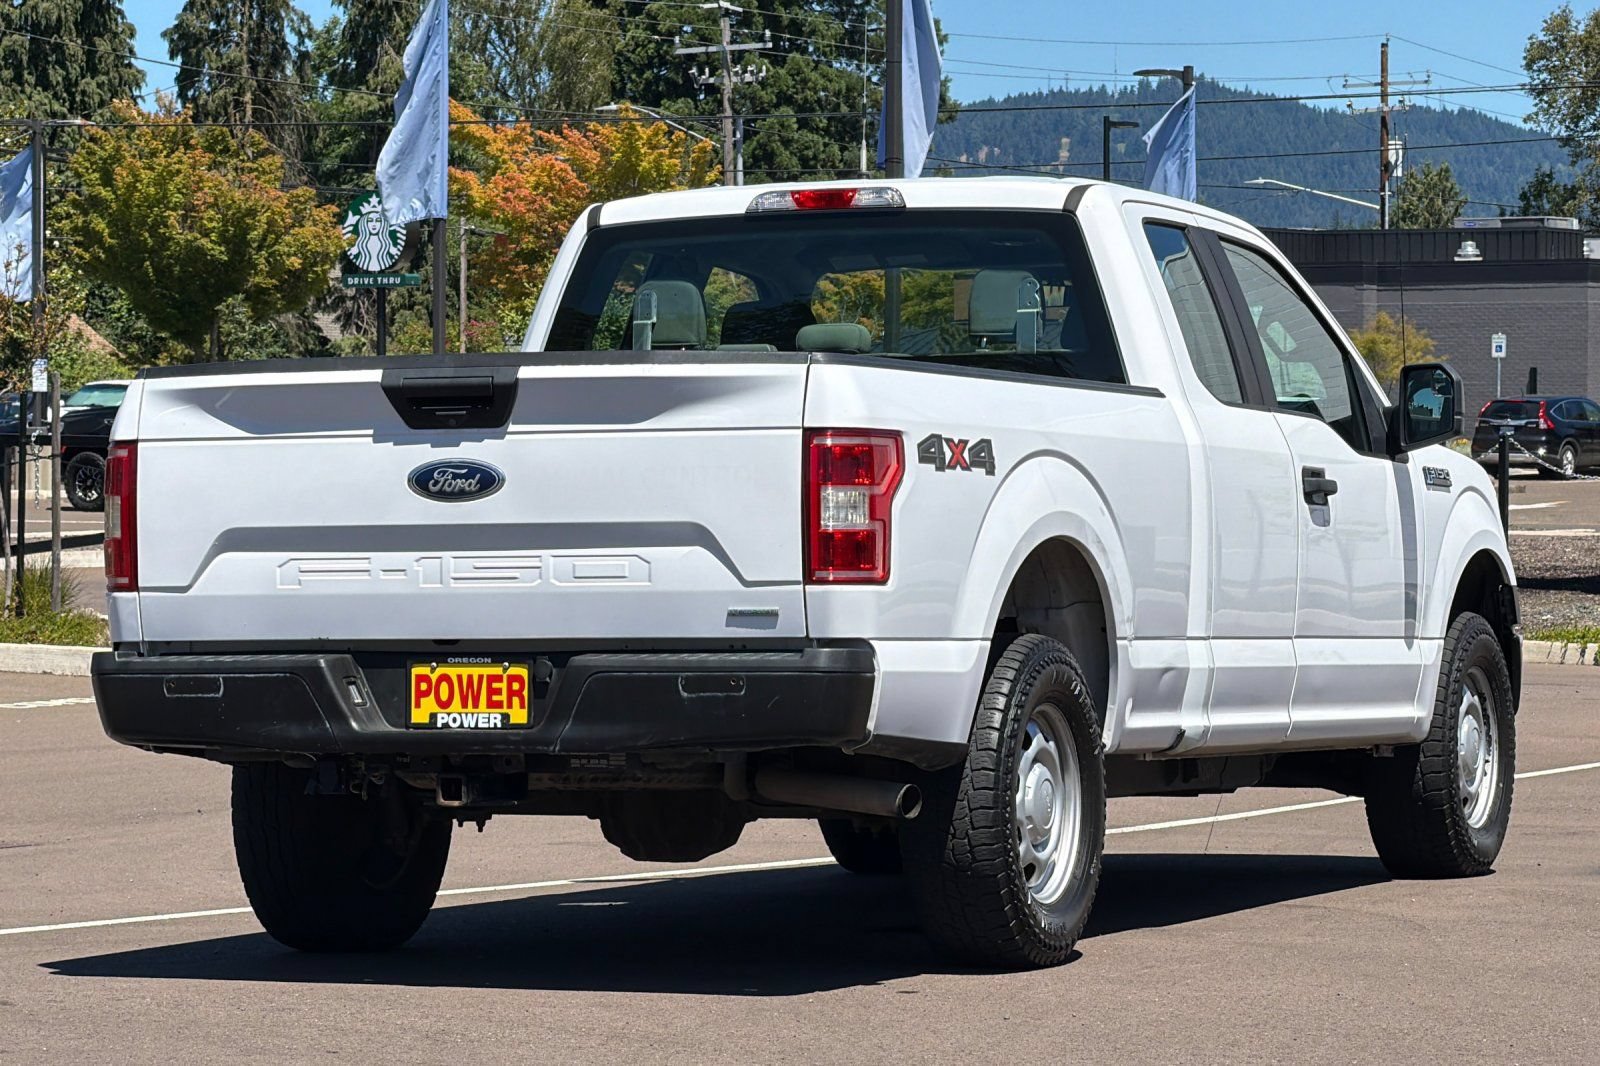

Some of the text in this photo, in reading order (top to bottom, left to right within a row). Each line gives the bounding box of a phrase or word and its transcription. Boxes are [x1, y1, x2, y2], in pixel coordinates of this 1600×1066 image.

[347, 276, 401, 285] DRIVE THRU
[428, 467, 481, 493] Ford
[276, 554, 652, 589] F-150
[414, 672, 526, 710] POWER
[436, 712, 502, 728] POWER
